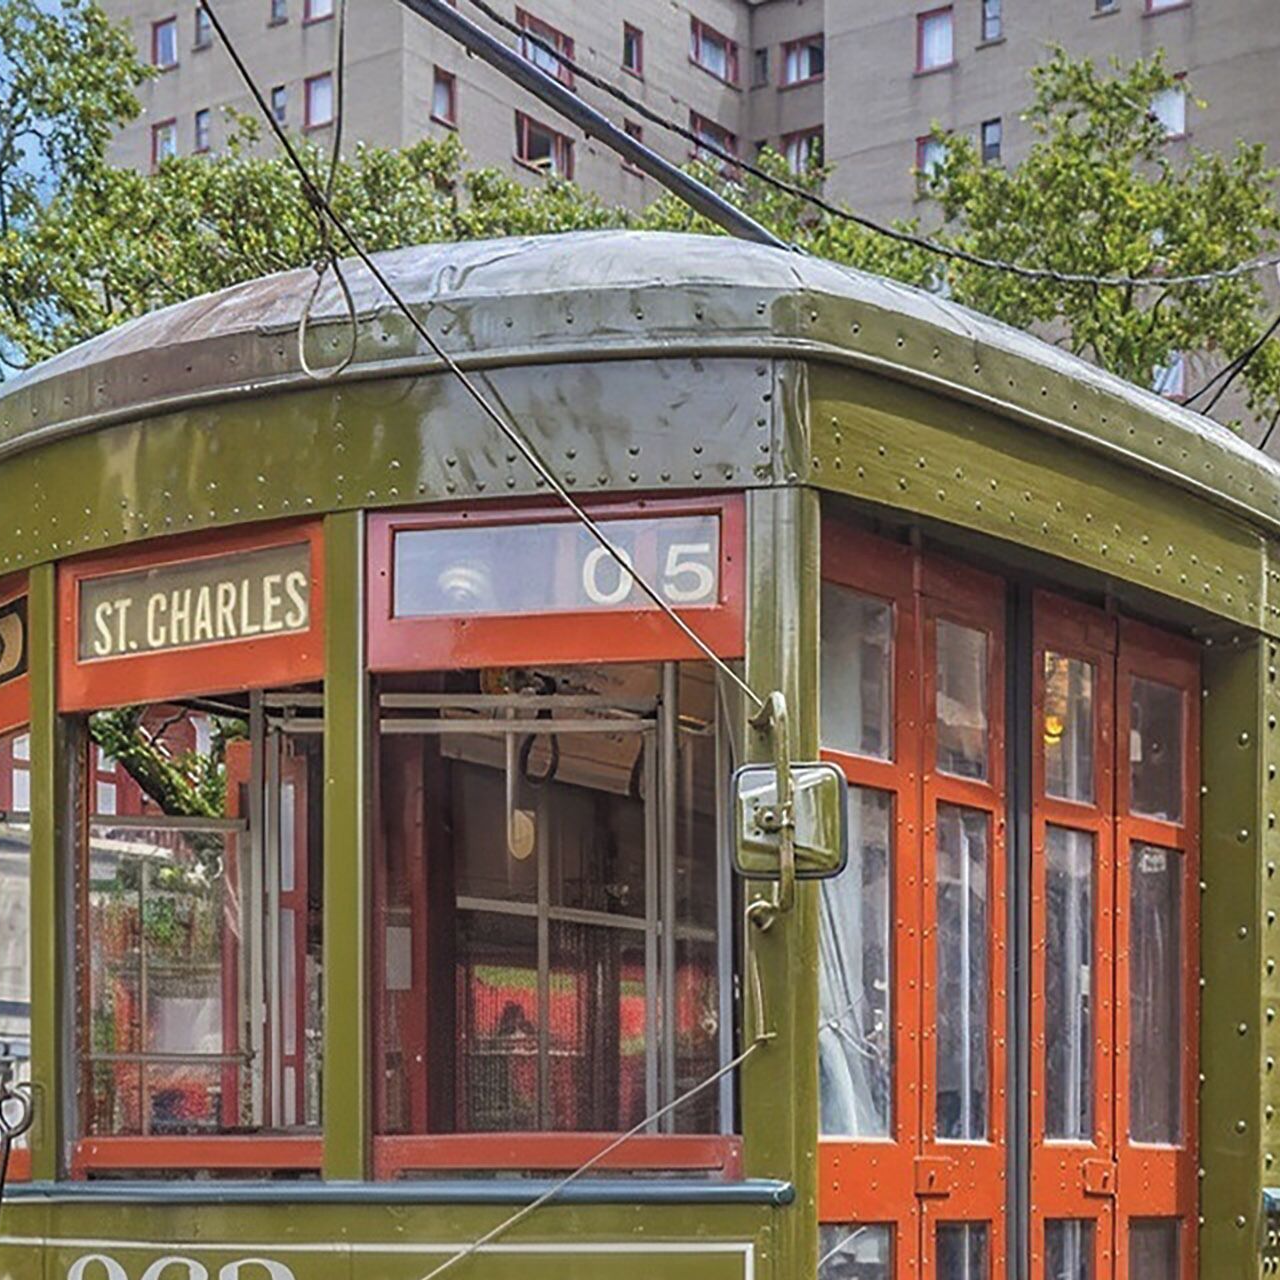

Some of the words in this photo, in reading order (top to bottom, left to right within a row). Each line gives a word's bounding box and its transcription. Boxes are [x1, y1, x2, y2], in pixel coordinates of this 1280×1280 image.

[582, 542, 715, 605] 05
[93, 596, 138, 657] ST.
[146, 570, 308, 649] CHARLES
